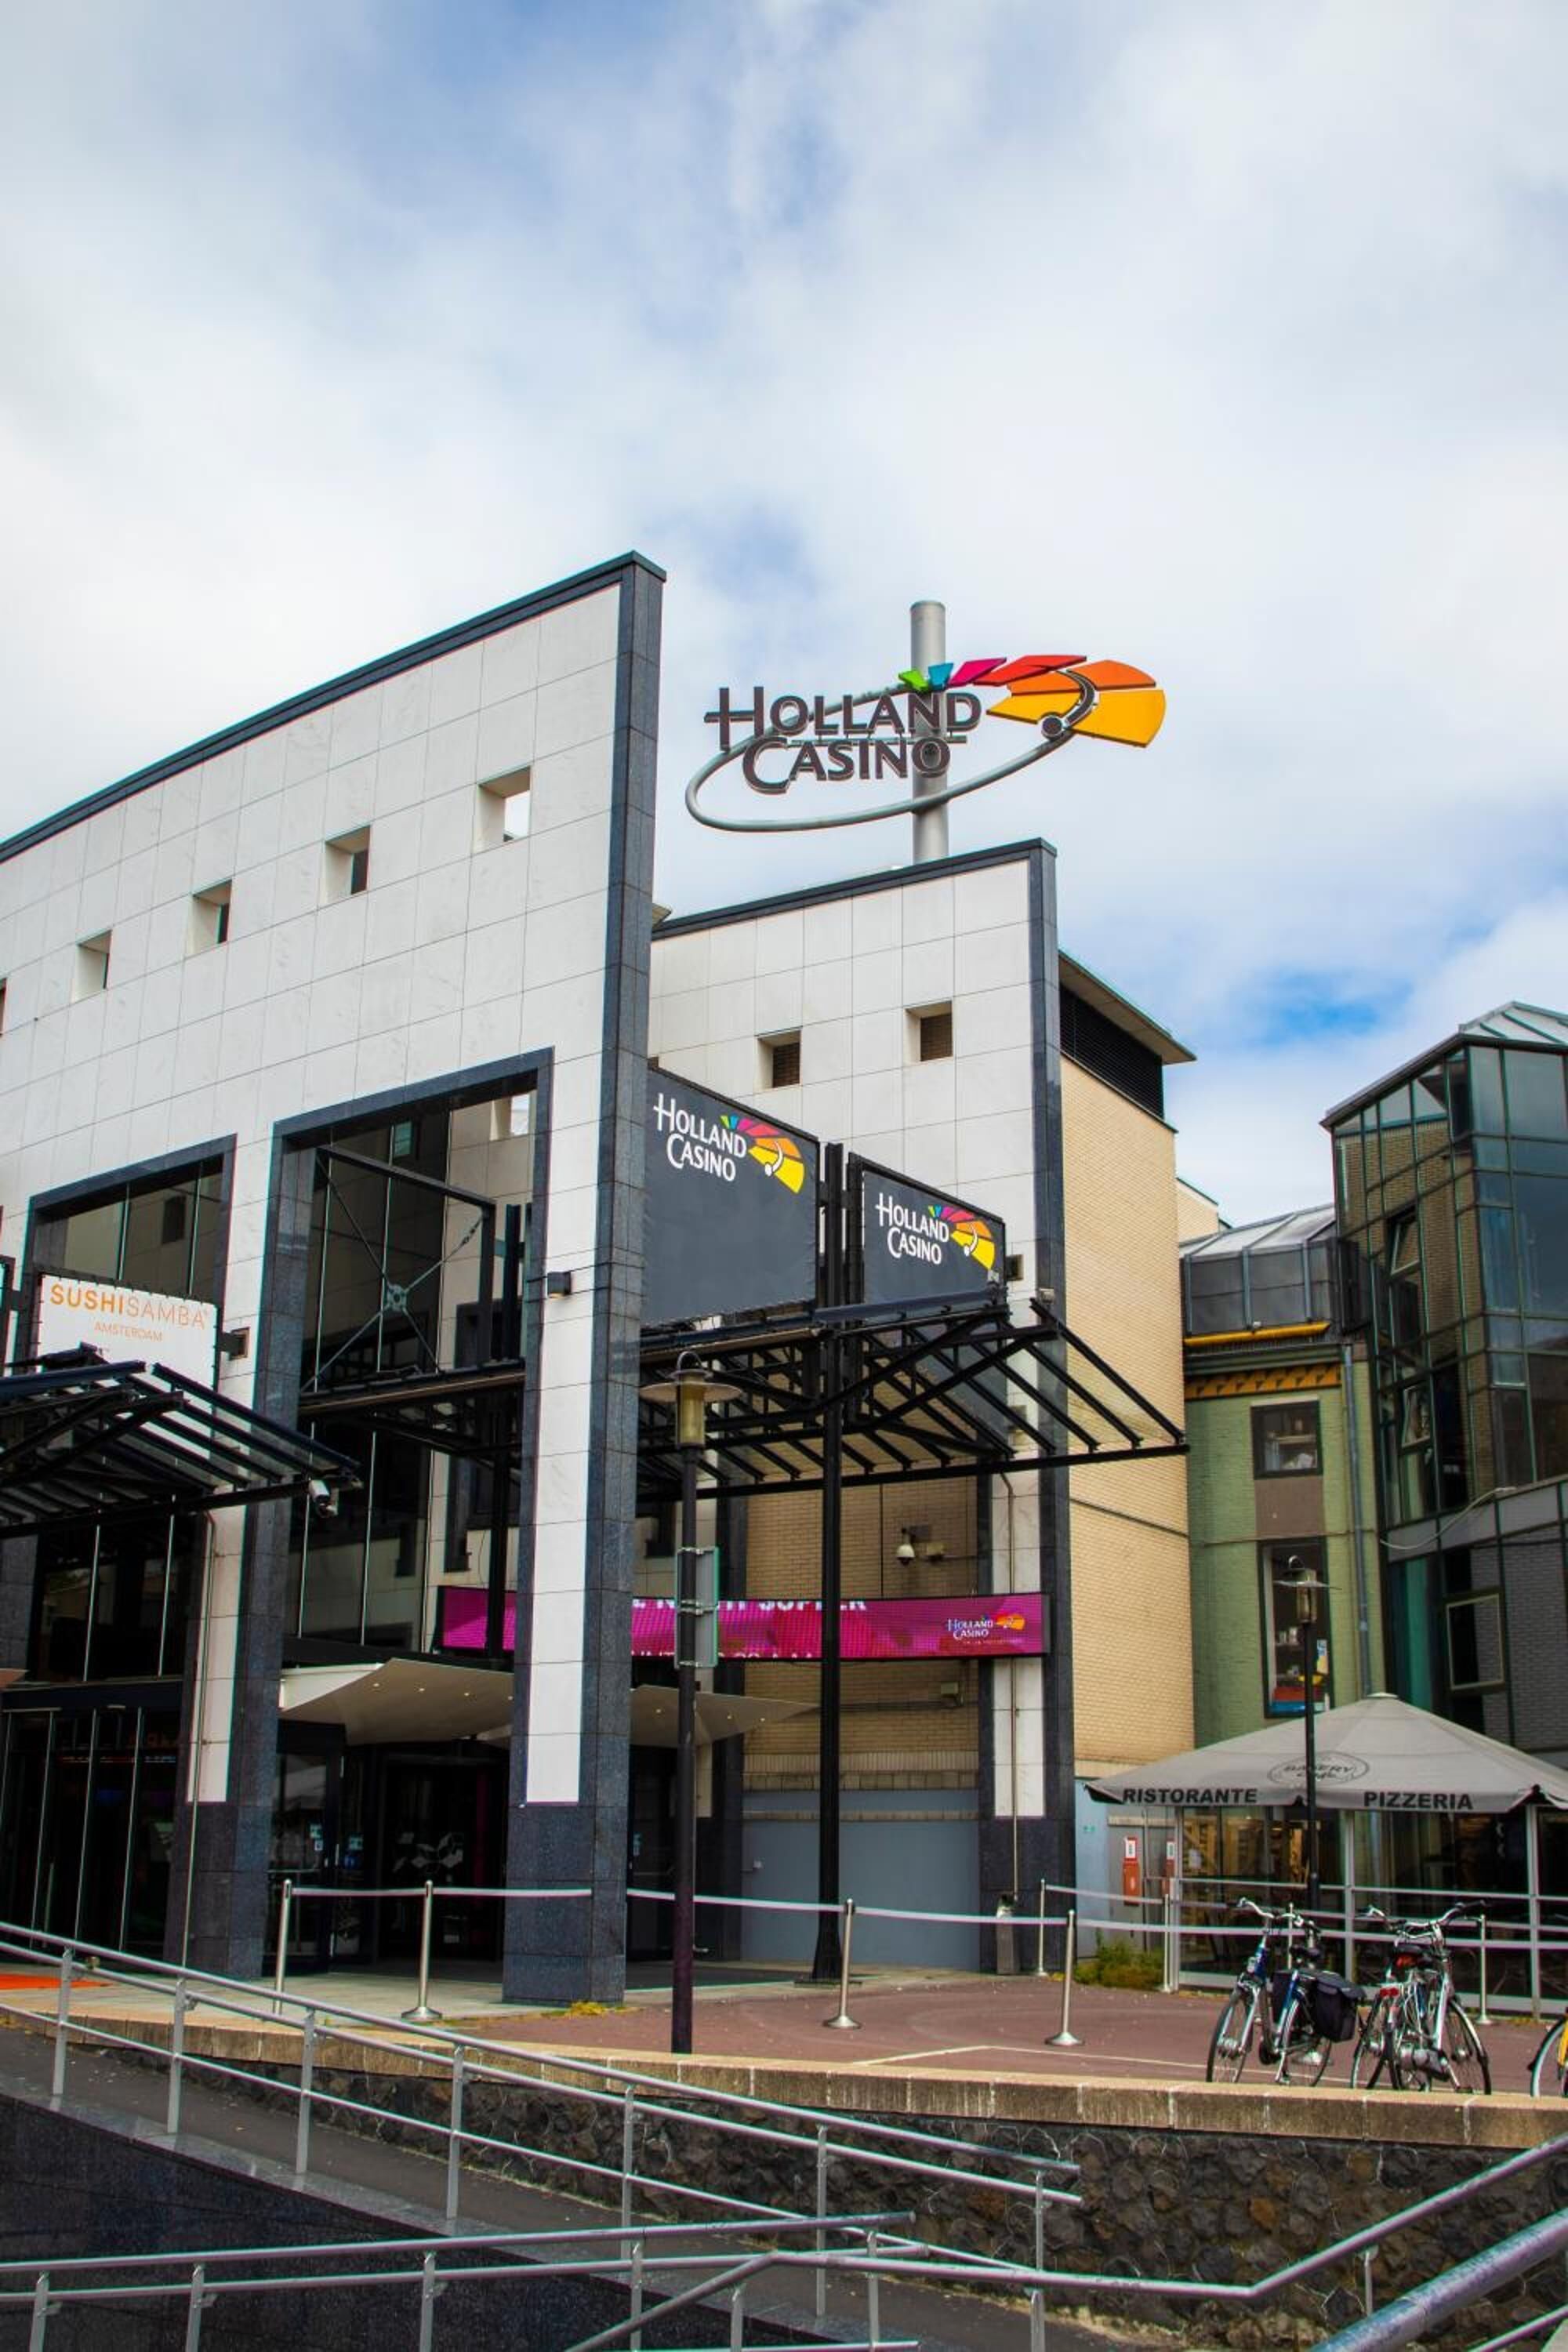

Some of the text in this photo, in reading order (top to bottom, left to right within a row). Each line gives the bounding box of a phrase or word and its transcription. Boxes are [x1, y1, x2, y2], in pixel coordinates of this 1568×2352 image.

[704, 686, 982, 752] HOLLAND
[742, 735, 950, 793] CASINO
[653, 1093, 747, 1159] HOLLAND
[666, 1133, 737, 1181] CASINO
[875, 1192, 950, 1243] HOLLAND
[887, 1228, 942, 1265] CASINO
[94, 1321, 163, 1341] AMSTERDAM
[946, 1618, 993, 1631] HOLLAND
[953, 1629, 989, 1640] CASINO
[1123, 1788, 1258, 1805] RISTORANTE
[1364, 1791, 1474, 1810] PIZZERIA
